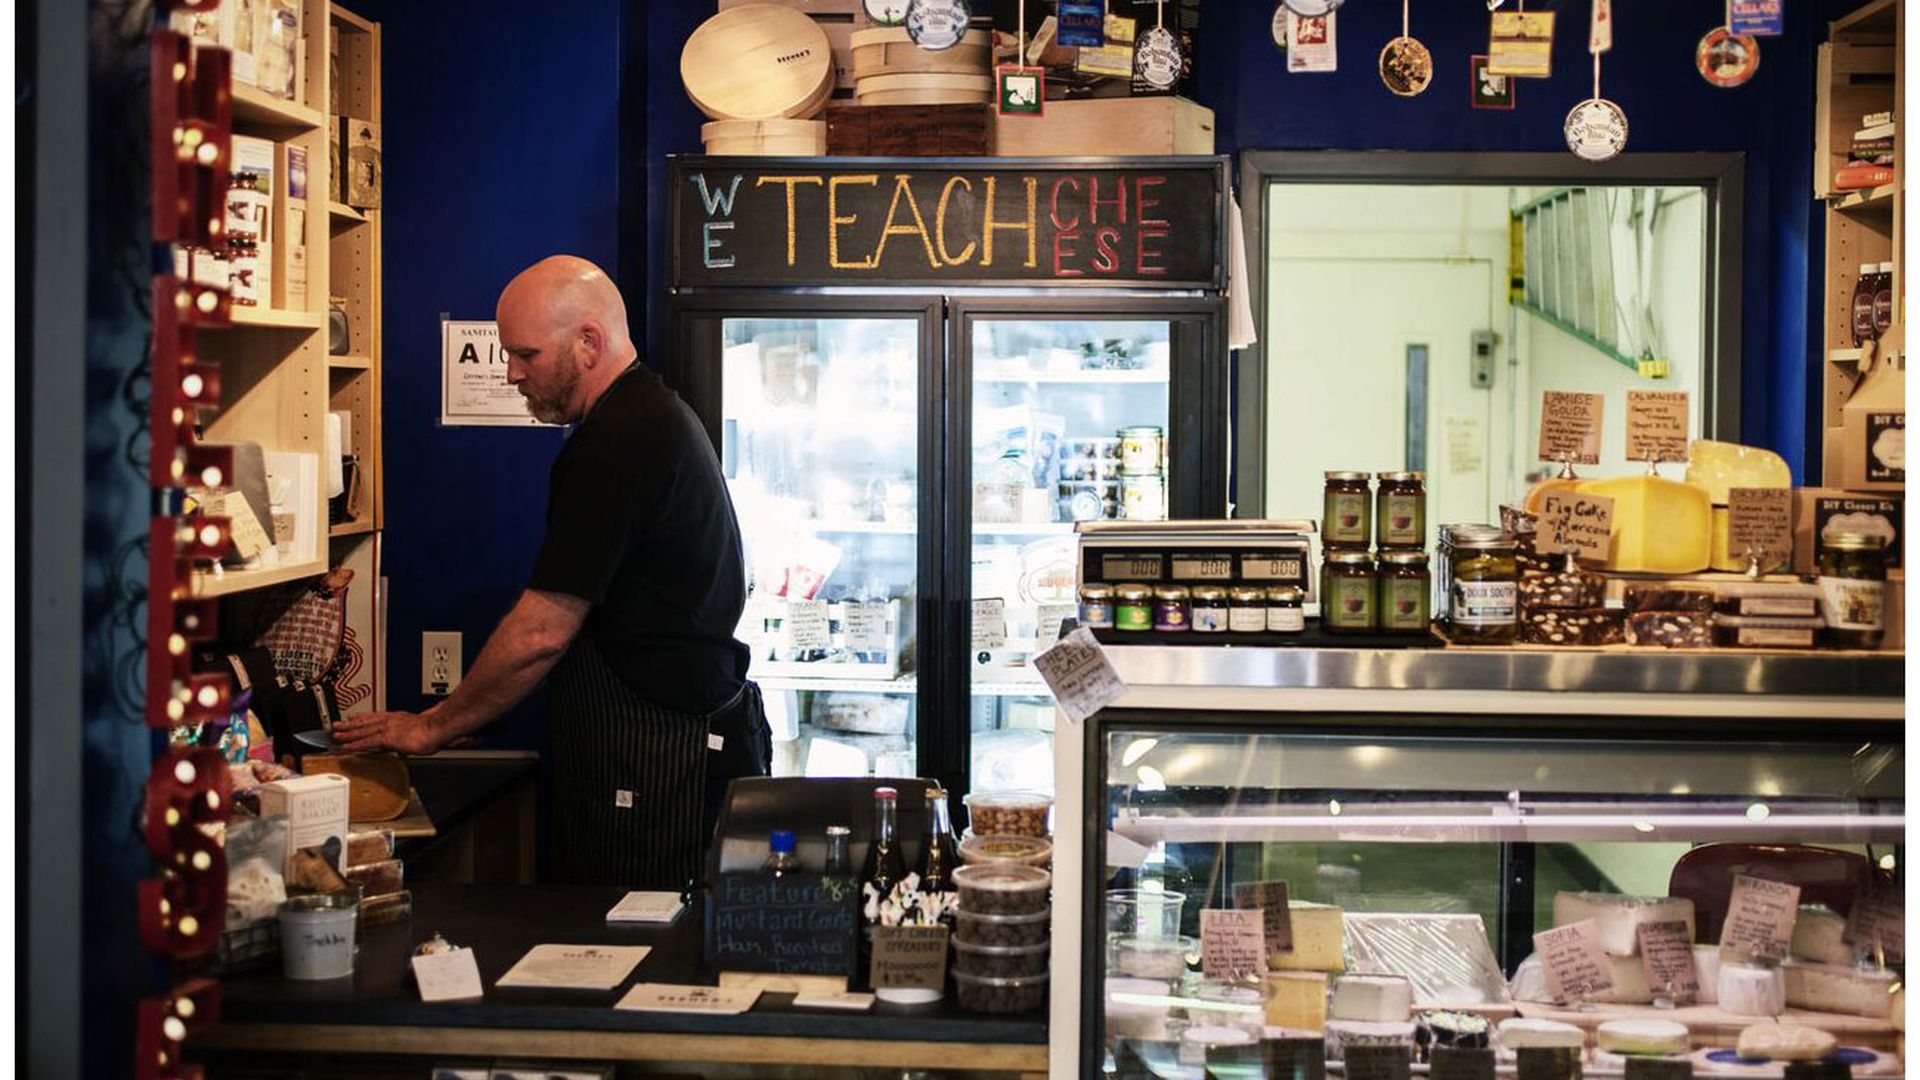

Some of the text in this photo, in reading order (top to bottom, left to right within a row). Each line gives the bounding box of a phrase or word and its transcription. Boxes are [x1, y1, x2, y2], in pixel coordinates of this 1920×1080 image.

[757, 174, 1038, 269] TEACH
[459, 342, 480, 364] A
[1548, 404, 1590, 416] GOUDA
[1546, 496, 1571, 521] Fig
[1823, 502, 1839, 510] DIY
[1844, 502, 1875, 511] Cheese
[726, 877, 830, 904] Feature
[717, 908, 803, 931] Mustard
[1543, 926, 1581, 946] SOFIA
